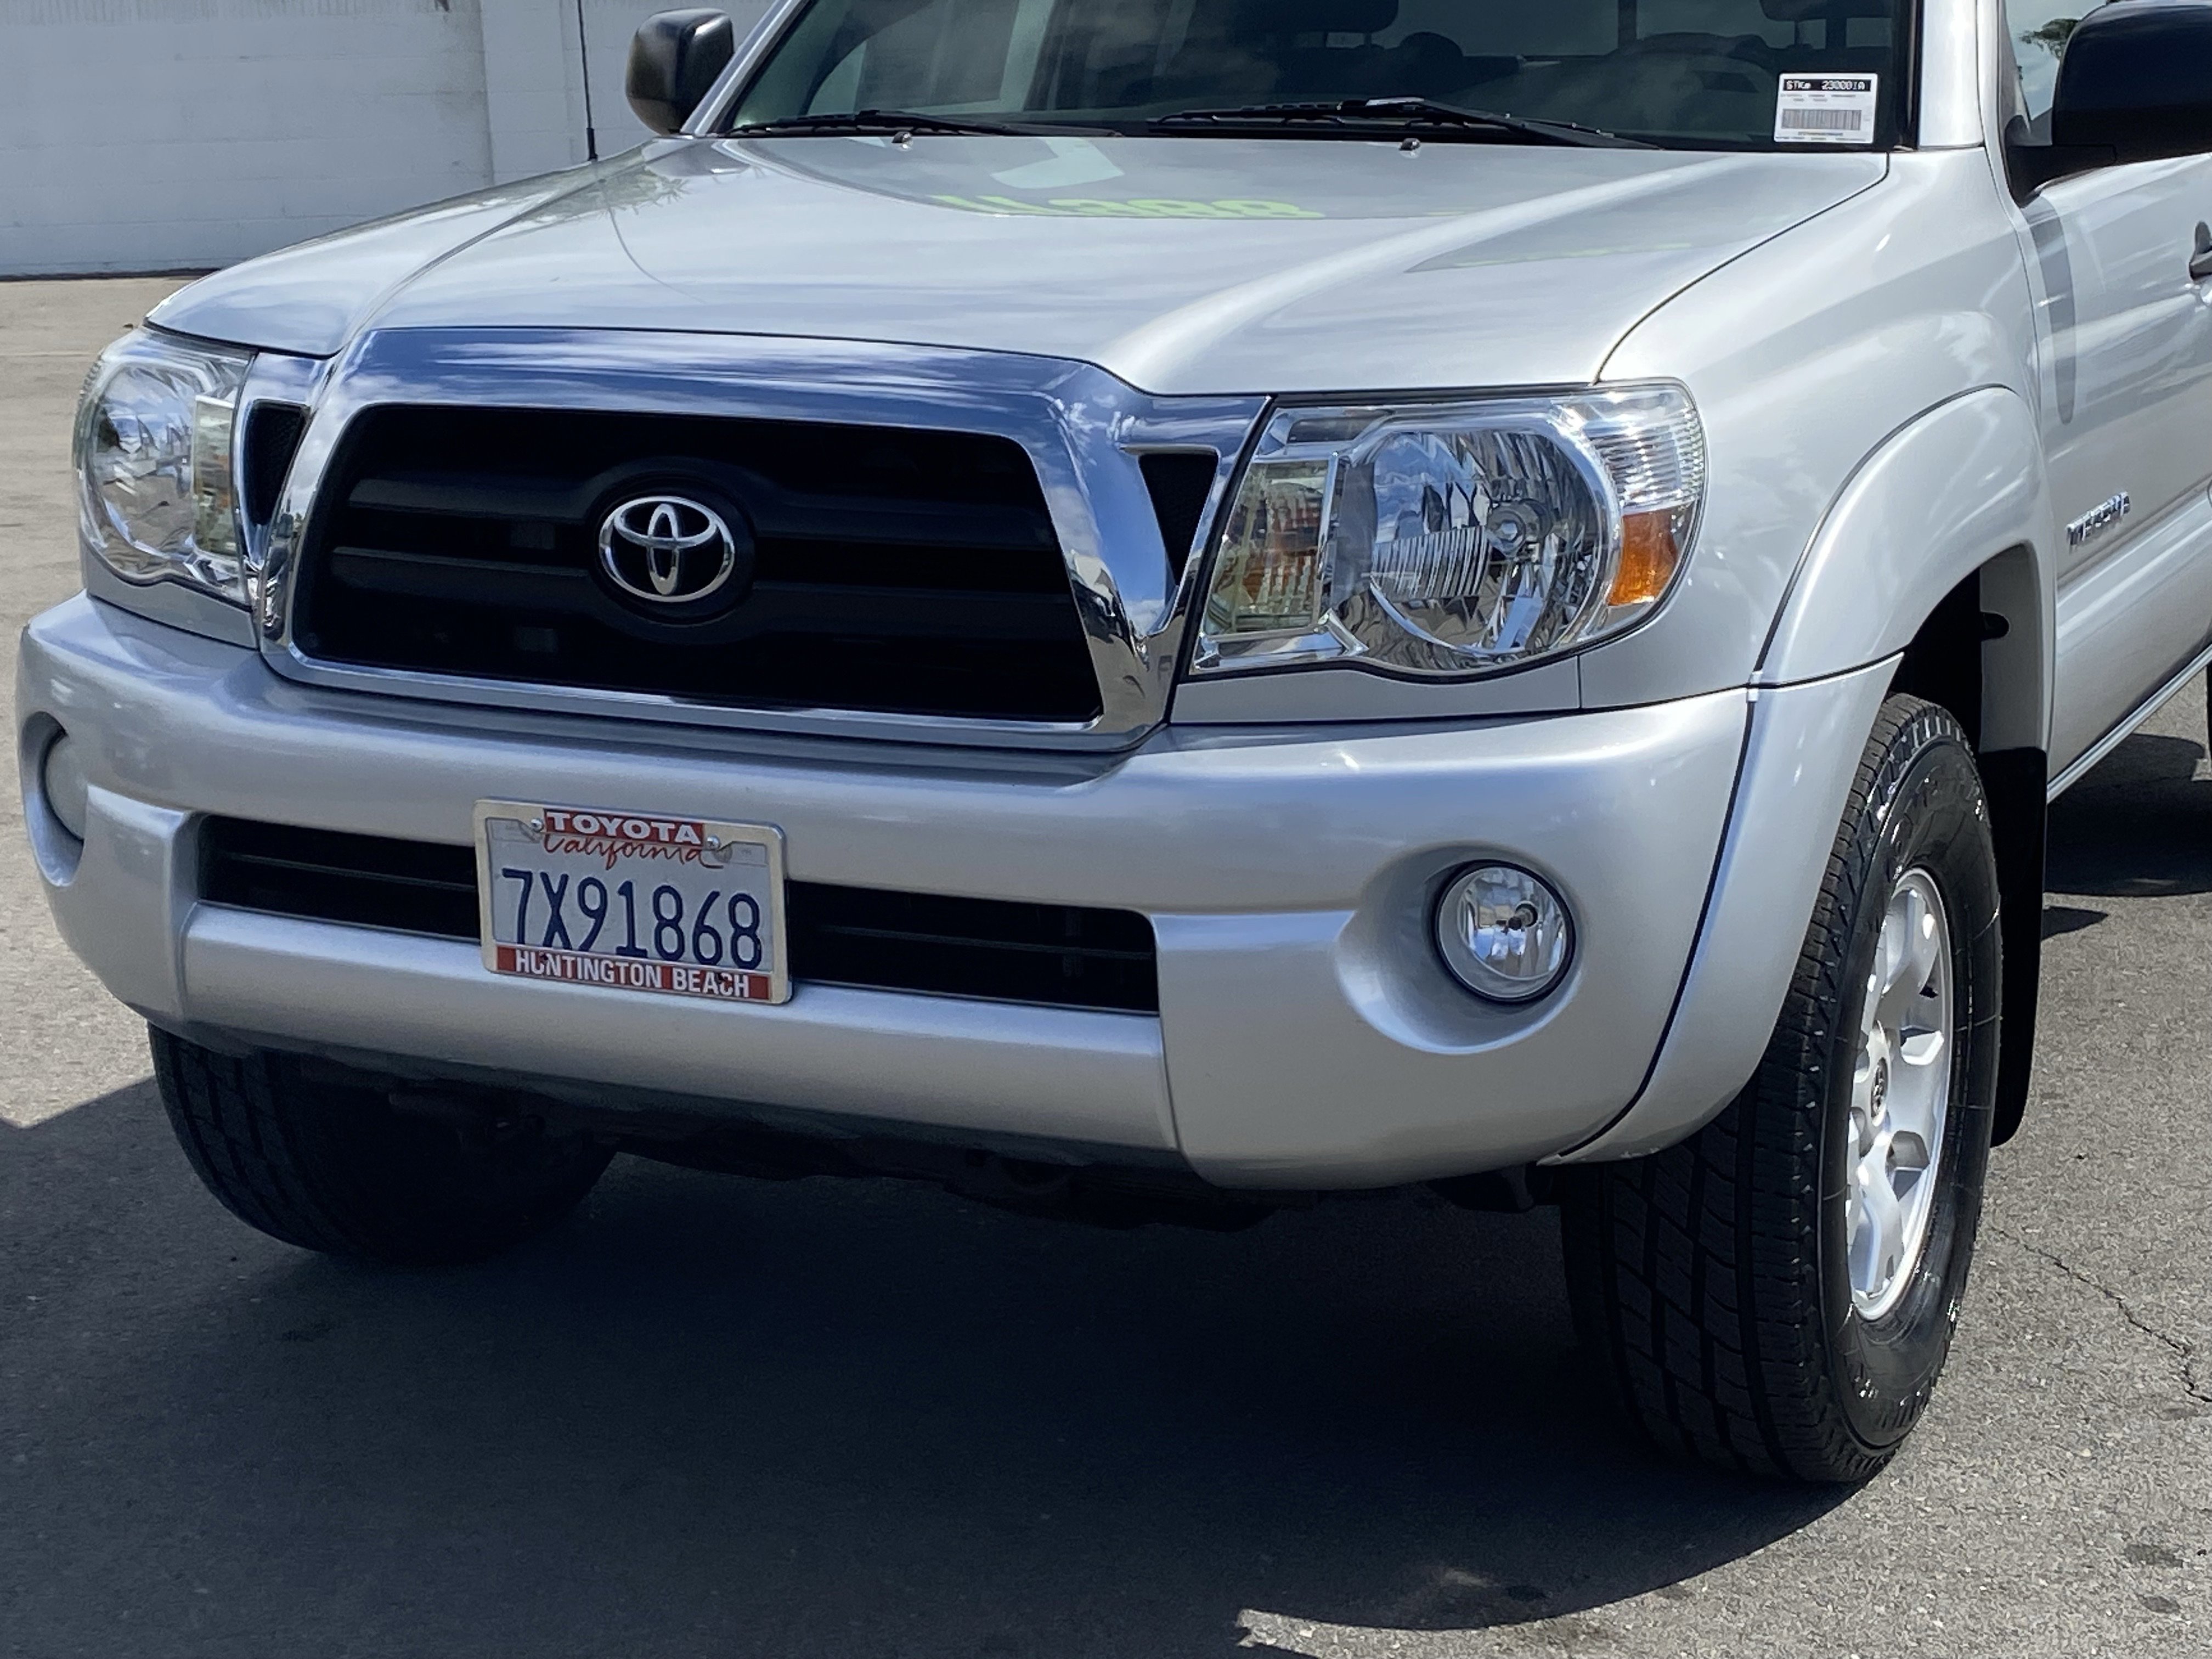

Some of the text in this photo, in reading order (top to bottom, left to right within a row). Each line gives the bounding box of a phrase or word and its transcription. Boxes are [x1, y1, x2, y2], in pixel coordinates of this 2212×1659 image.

[546, 812, 701, 844] TOYOTA
[544, 833, 723, 870] California
[502, 868, 762, 970] 7X91868
[515, 949, 749, 998] HUNTINGTON BEACH
